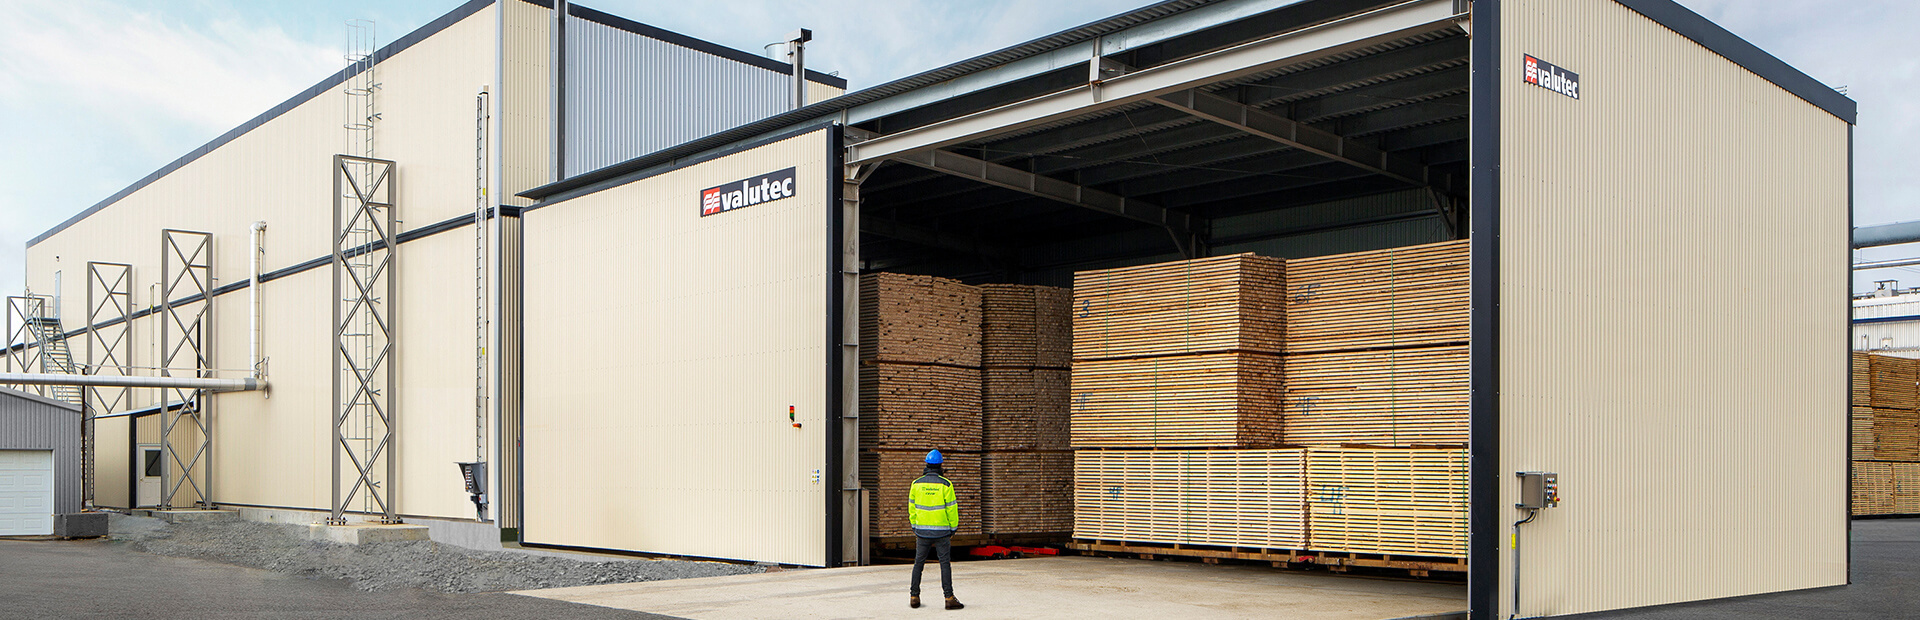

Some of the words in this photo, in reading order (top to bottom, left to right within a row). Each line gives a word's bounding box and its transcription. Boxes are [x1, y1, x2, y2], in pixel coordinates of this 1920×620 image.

[1537, 65, 1579, 99] valutec
[721, 177, 793, 211] valutec
[1079, 299, 1090, 318] 3
